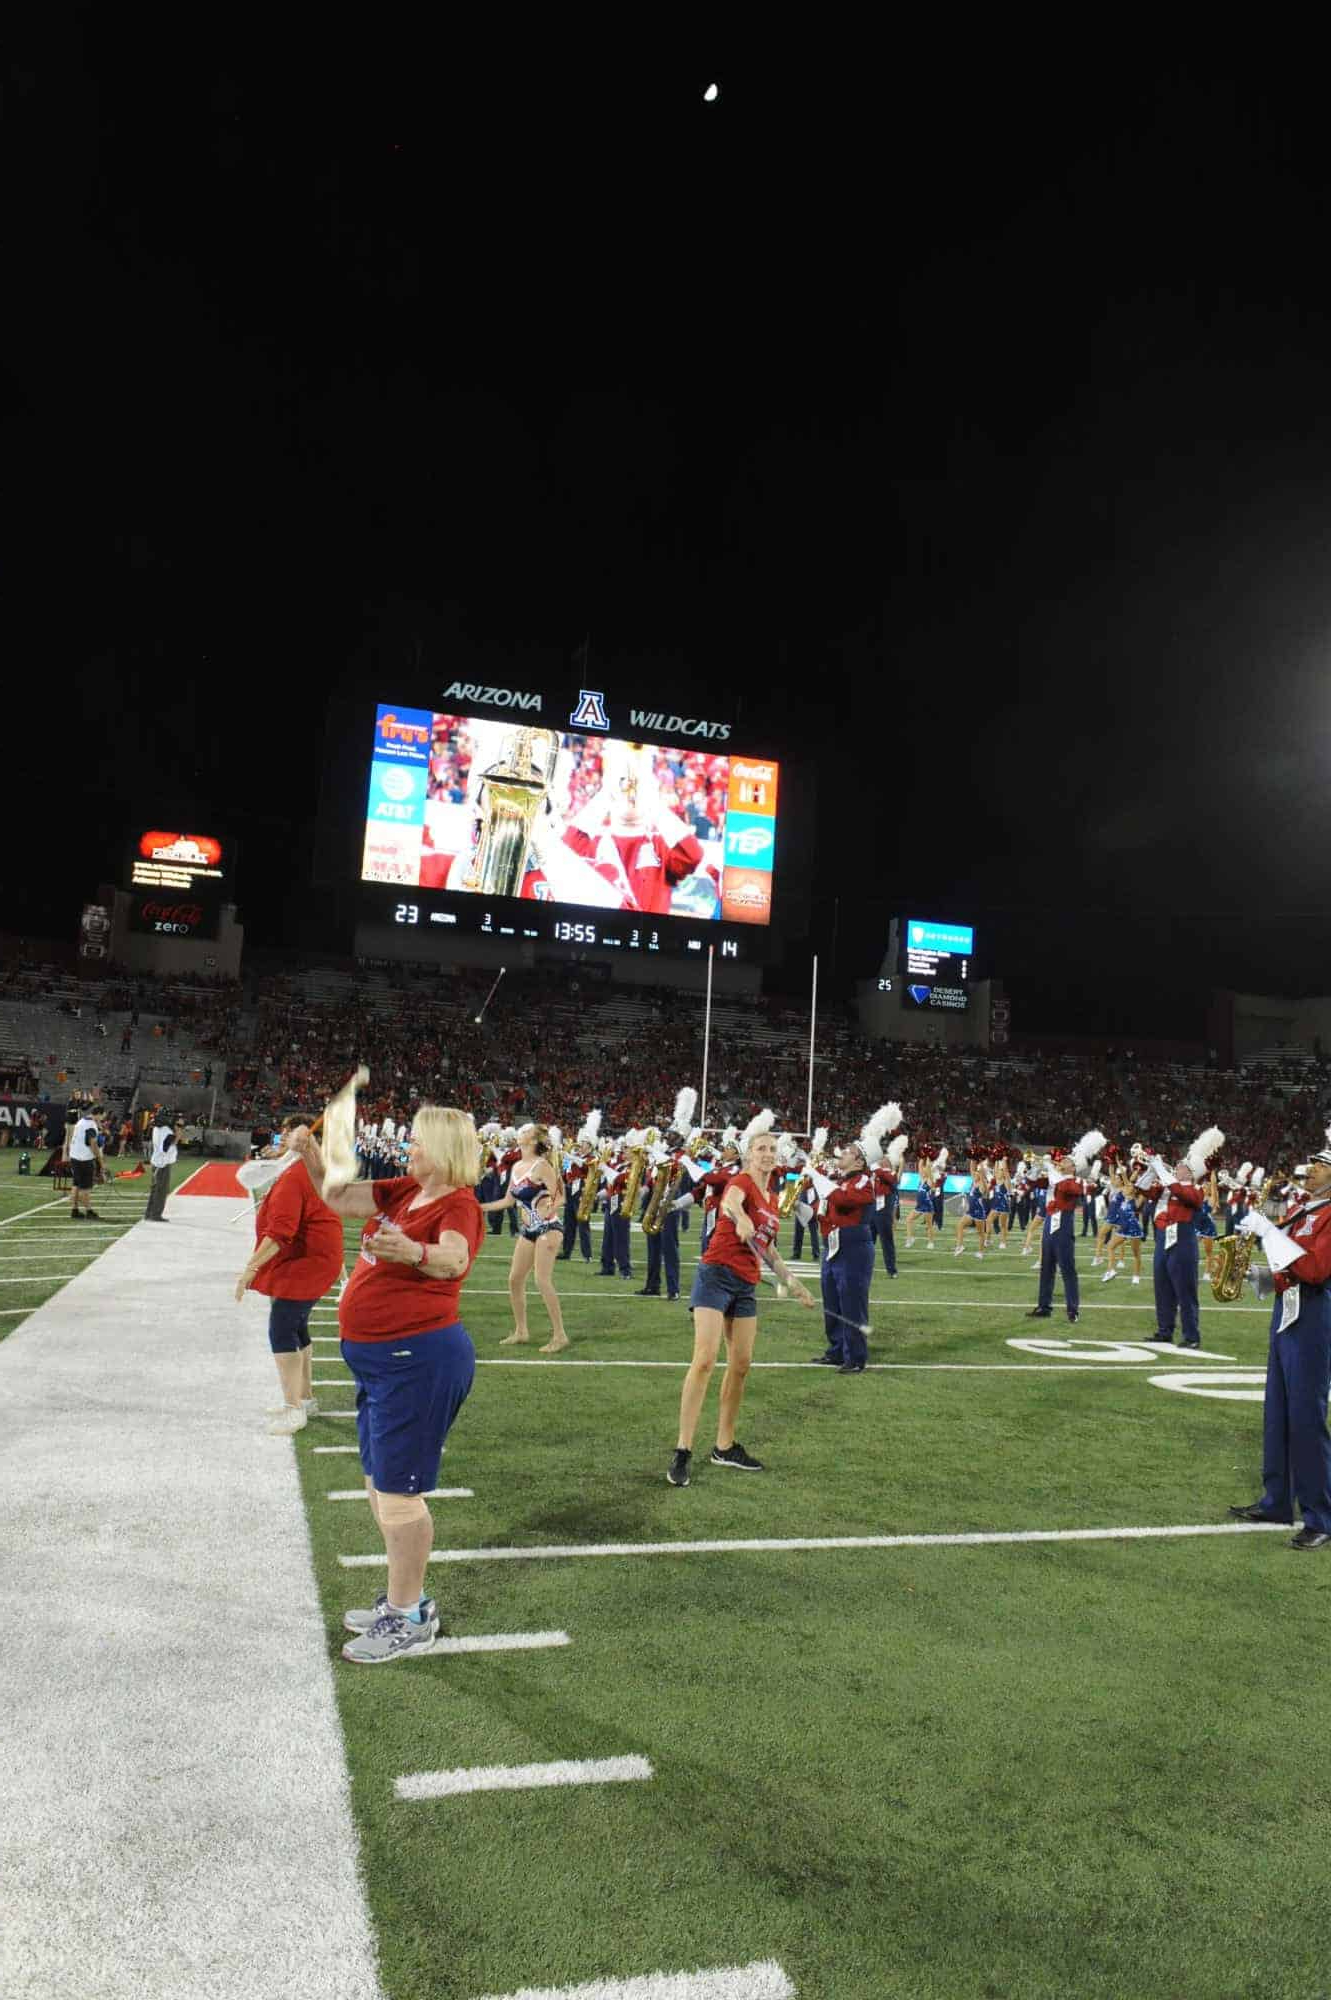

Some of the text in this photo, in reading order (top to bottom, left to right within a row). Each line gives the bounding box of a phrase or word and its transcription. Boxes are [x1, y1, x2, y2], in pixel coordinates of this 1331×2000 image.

[443, 681, 542, 712] ARIZONA
[570, 690, 610, 729] A
[630, 710, 732, 740] WILDCATS
[728, 828, 772, 856] TEP
[395, 903, 418, 924] 23
[484, 913, 491, 925] 3
[154, 921, 188, 934] zero
[554, 921, 596, 944] 13:55
[632, 930, 639, 941] 3
[651, 932, 659, 943] 3
[722, 940, 738, 957] 14
[878, 979, 892, 991] 25
[933, 986, 964, 995] DESERT
[930, 993, 967, 1002] DIAMOND
[930, 999, 966, 1009] CASINOS
